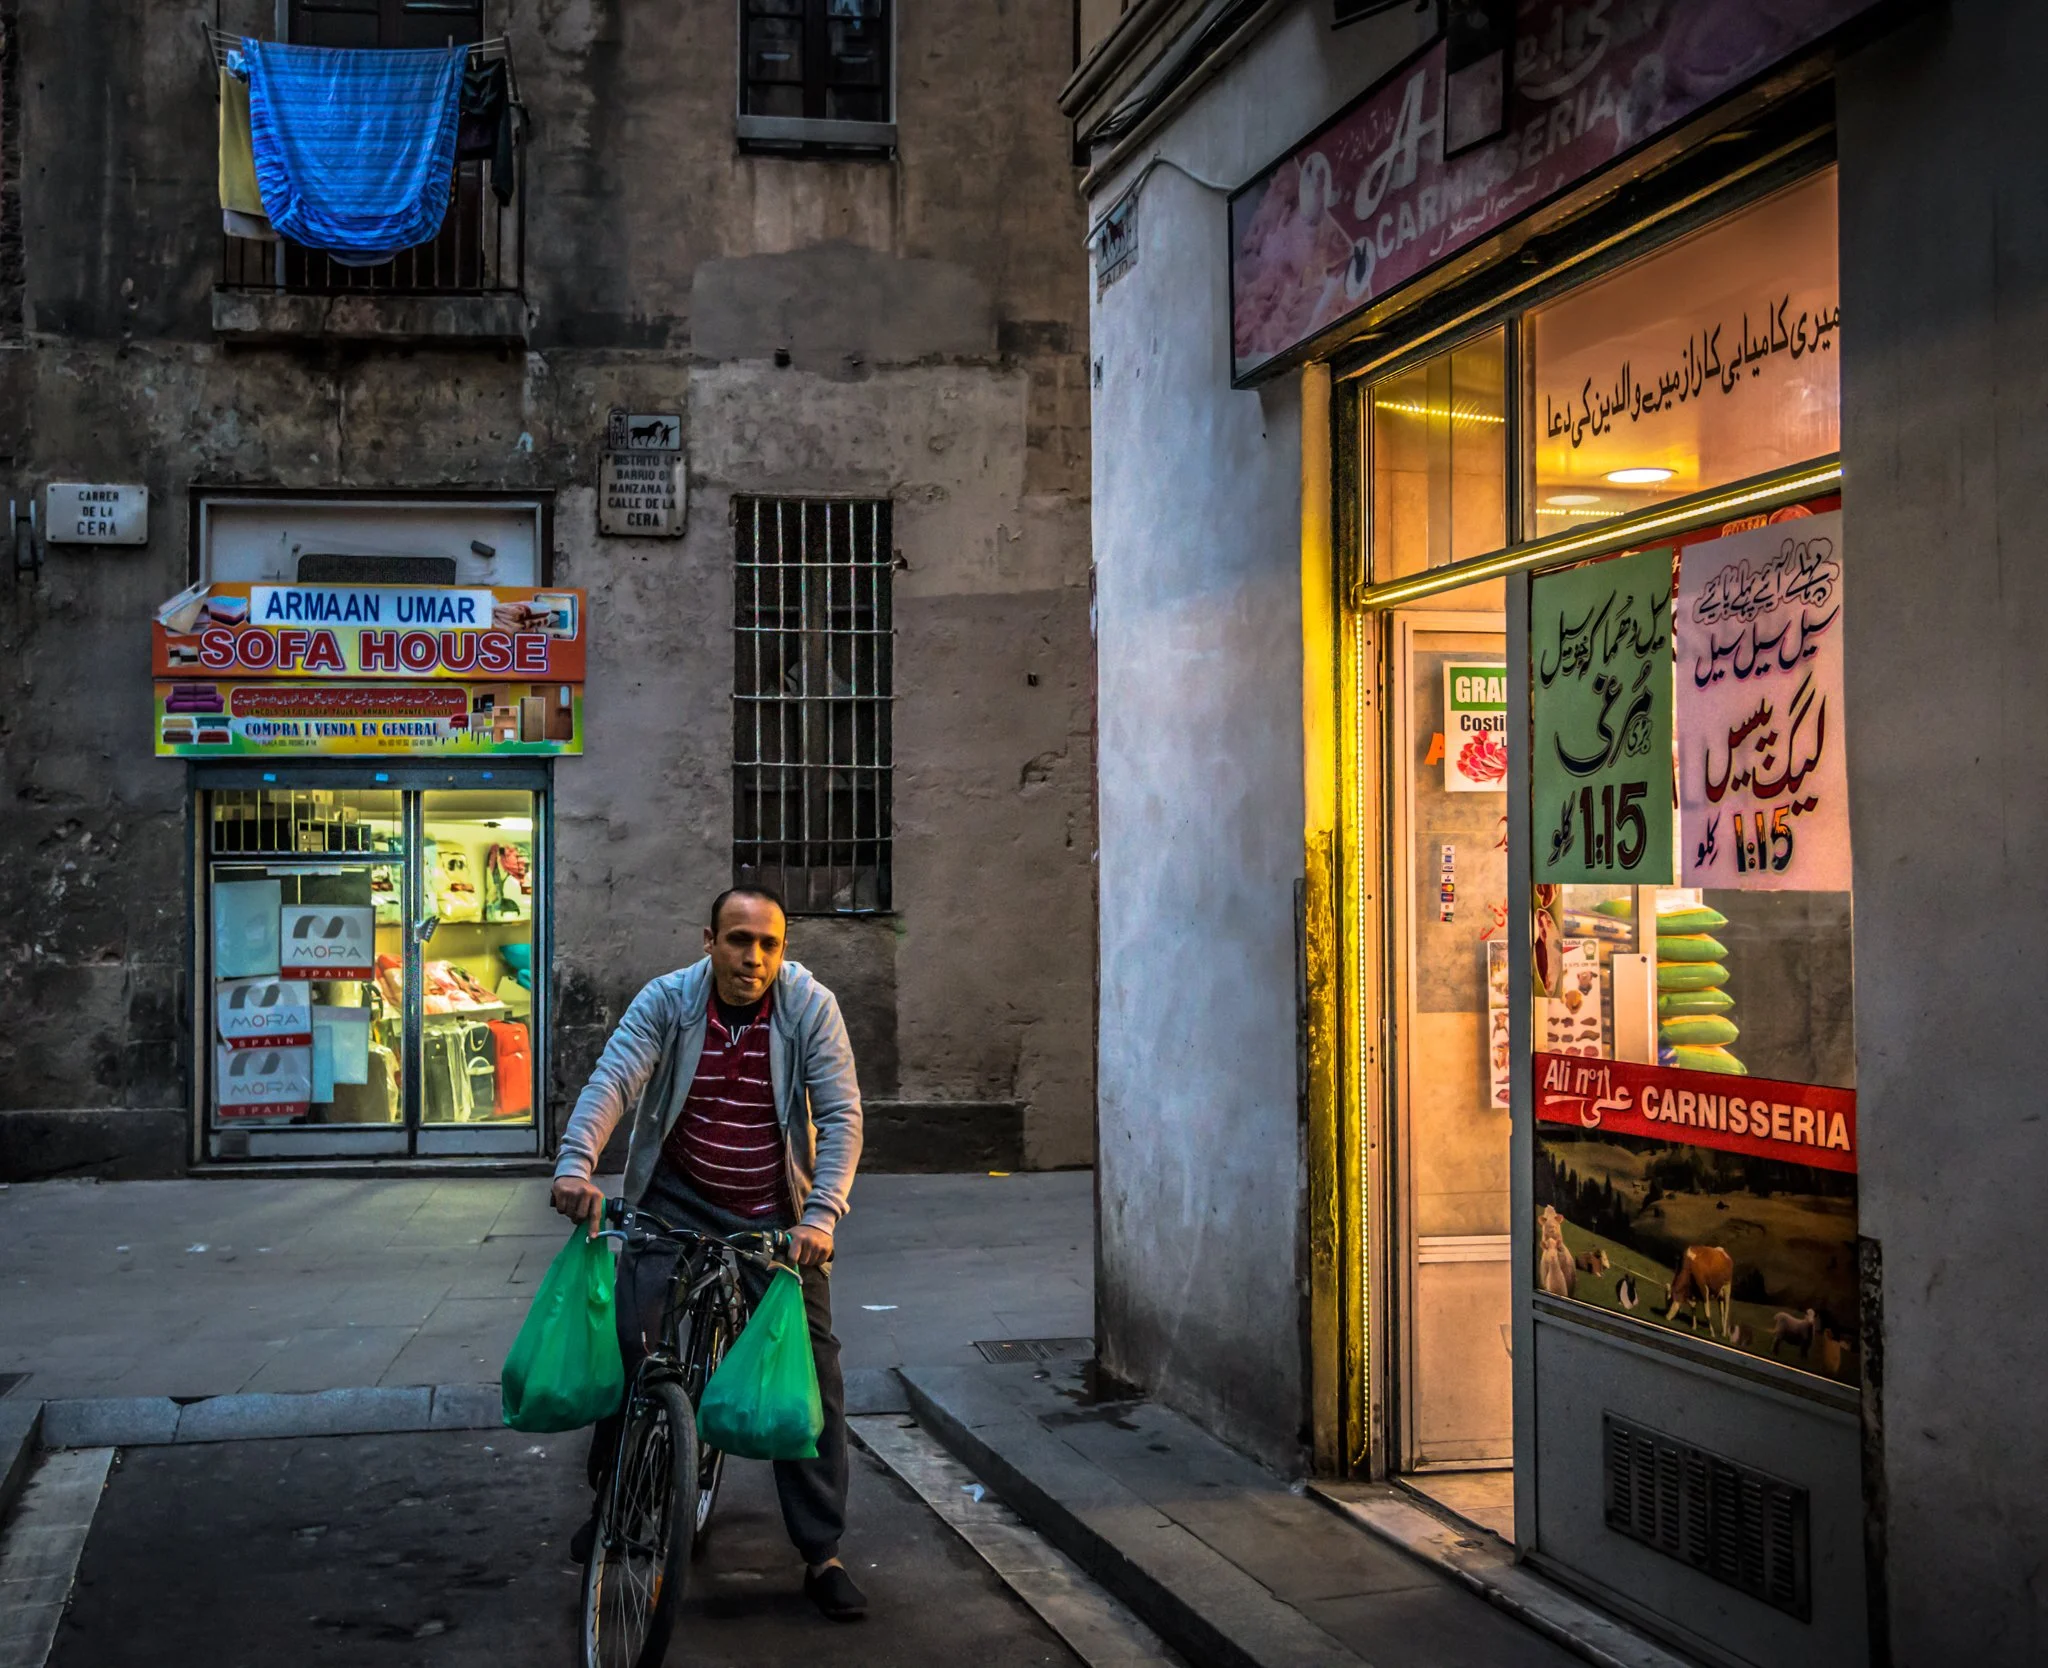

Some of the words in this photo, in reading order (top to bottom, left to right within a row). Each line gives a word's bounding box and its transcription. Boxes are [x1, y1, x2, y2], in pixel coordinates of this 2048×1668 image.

[1721, 294, 1790, 394] کامیابی
[1547, 394, 1571, 439] دعا
[617, 469, 655, 480] BARRIO
[609, 483, 662, 494] MANZANA
[78, 491, 119, 501] CARRER
[608, 497, 642, 509] CALLE
[645, 498, 659, 509] DE
[662, 498, 675, 509] LA
[82, 507, 96, 517] DE
[100, 507, 114, 517] LA
[627, 512, 660, 526] CERA
[77, 521, 118, 536] CERA
[265, 591, 379, 622] ARMAAN
[396, 595, 476, 623] UMAR
[199, 628, 346, 671] SOFA
[360, 629, 550, 673] HOUSE
[245, 723, 299, 736] COMPRA
[304, 723, 310, 736] I
[315, 723, 356, 736] VENDA
[362, 723, 377, 736] EN
[382, 723, 439, 736] GENERAL
[1460, 714, 1507, 731] Costi
[292, 945, 362, 959] MORA
[299, 969, 355, 978] SPAIN
[230, 1013, 300, 1029] MORA
[238, 1037, 294, 1048] SPAIN
[1543, 1059, 1571, 1092] Ali
[230, 1080, 301, 1096] MORA
[237, 1103, 295, 1116] SPAIN
[1640, 1084, 1852, 1152] CARNISSERIA
